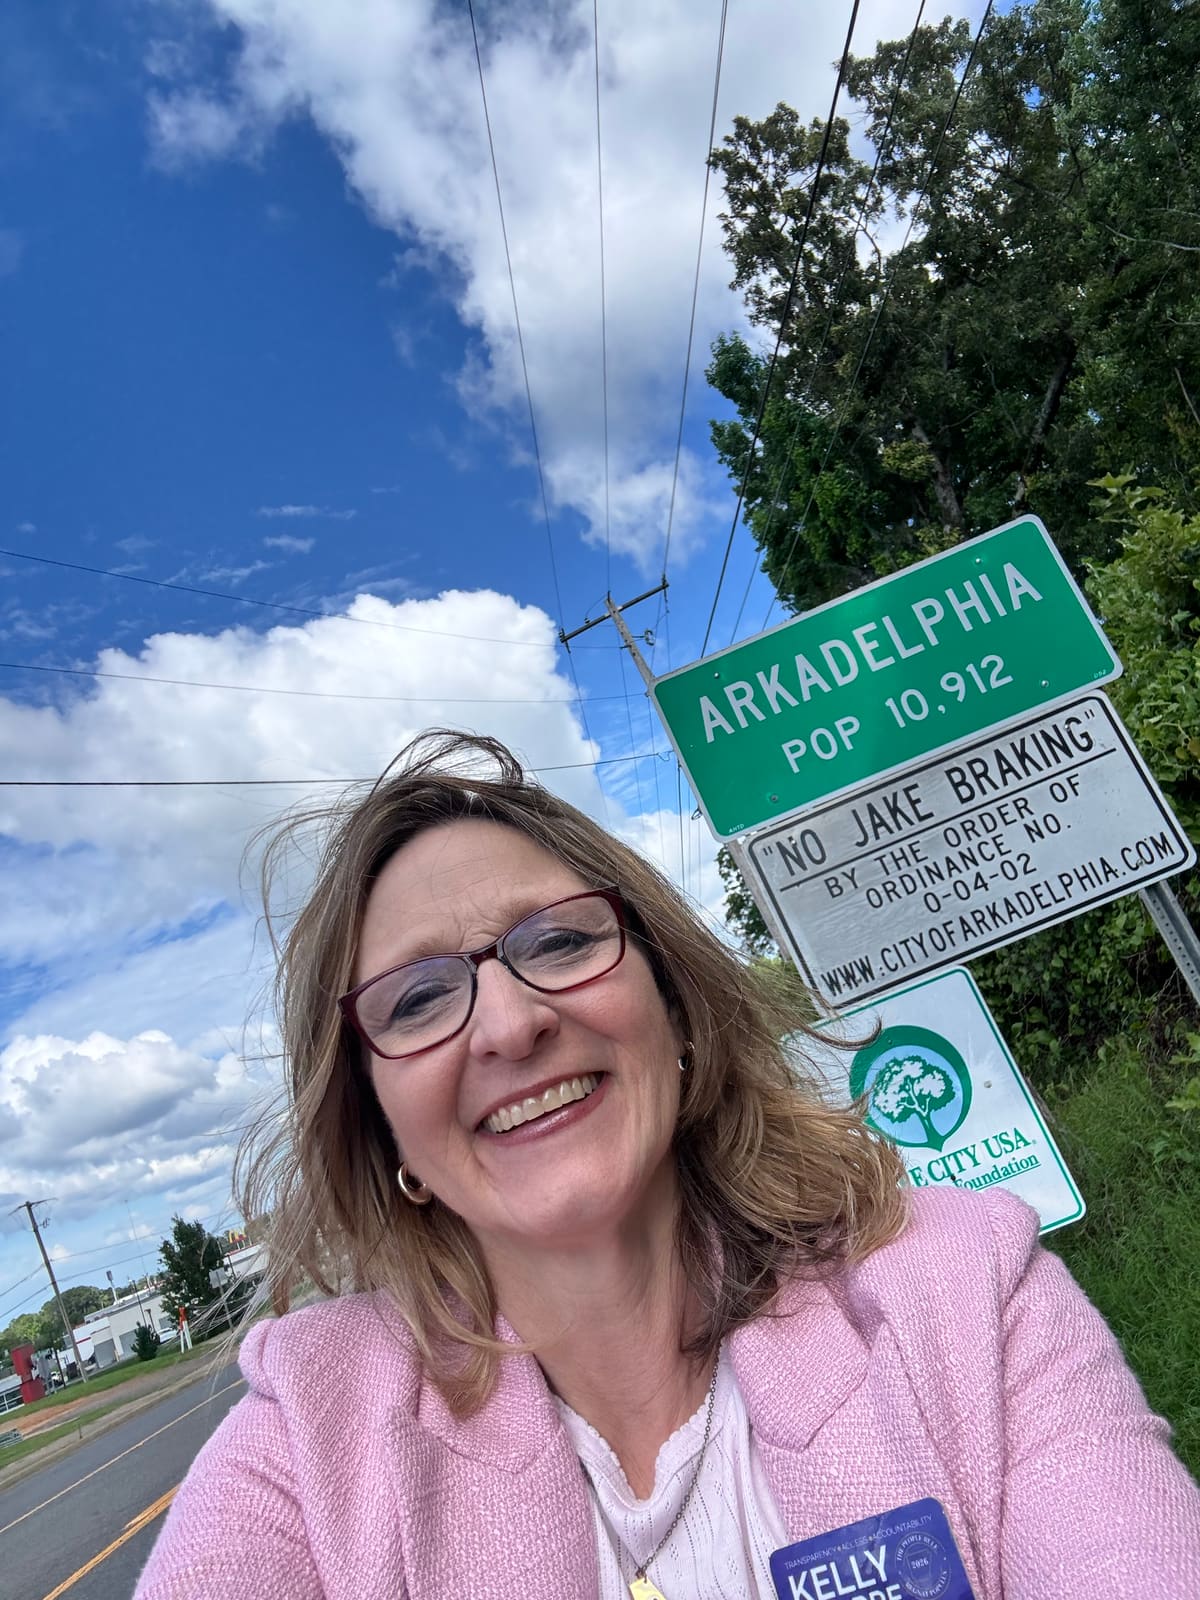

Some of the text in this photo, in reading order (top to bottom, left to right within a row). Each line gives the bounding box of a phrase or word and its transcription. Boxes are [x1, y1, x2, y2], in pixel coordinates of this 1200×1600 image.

[699, 562, 1043, 743] ARKADELPHIA
[781, 654, 1014, 774] POP 10,912
[762, 709, 1096, 877] "NO JAKE BRAKING"
[824, 773, 1081, 899] BY THE ORDER OF
[820, 831, 1176, 997] WWW.CITYOFARKADELPHIA.COM
[865, 813, 1072, 910] ORDINANCE NO.
[927, 1144, 981, 1182] CITY
[981, 1127, 1032, 1159] USA
[953, 1154, 1040, 1191] Foundation
[788, 1544, 888, 1600] KELLY
[911, 1557, 929, 1569] 2026
